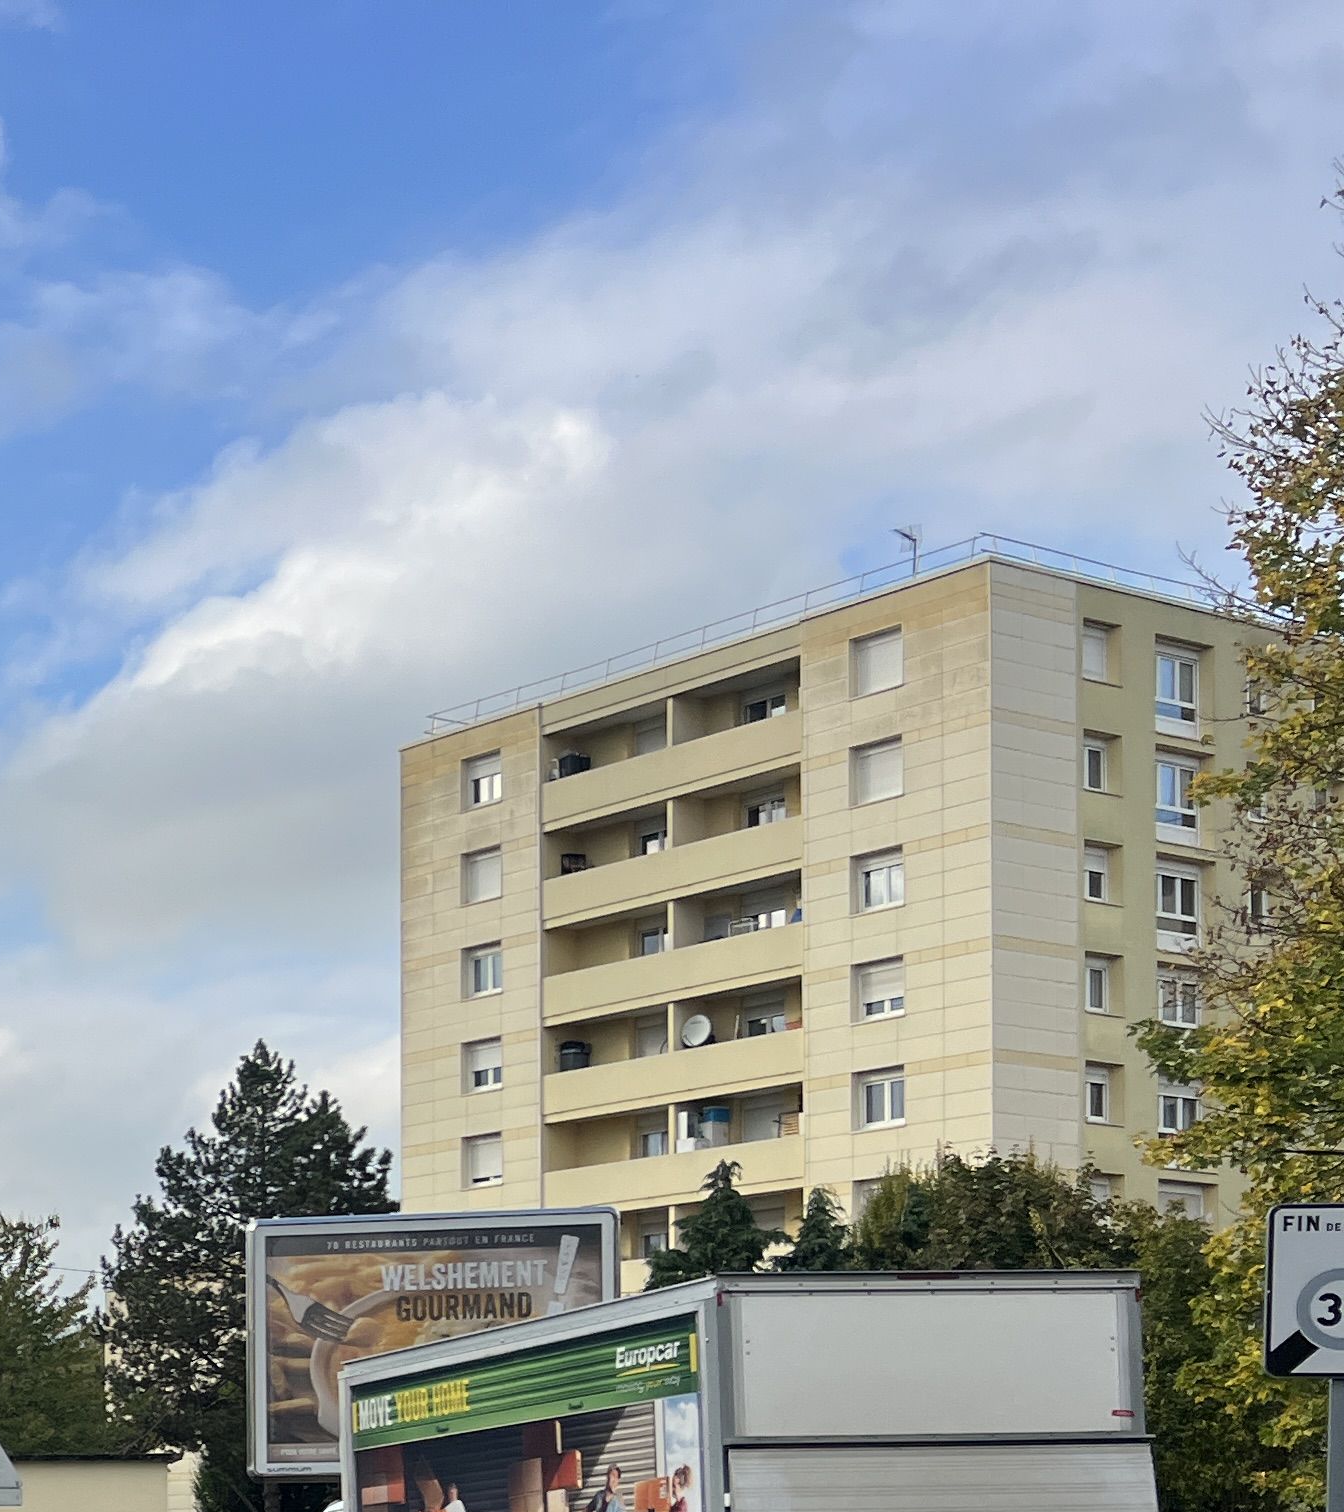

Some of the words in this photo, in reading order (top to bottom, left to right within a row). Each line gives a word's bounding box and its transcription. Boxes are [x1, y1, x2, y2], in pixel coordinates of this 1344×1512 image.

[1282, 1215, 1320, 1232] FIN
[1326, 1222, 1342, 1232] DE
[345, 1238, 418, 1250] RESTAURANTS
[422, 1236, 469, 1247] PARTOUT
[475, 1235, 489, 1245] EN
[494, 1233, 535, 1244] FRANCE
[381, 1259, 548, 1292] WELSHEMENT
[396, 1292, 533, 1322] GOURMAND
[615, 1341, 681, 1371] Europcar
[358, 1394, 393, 1431] MOVE
[395, 1387, 429, 1423] YOUR
[432, 1378, 471, 1417] HOME
